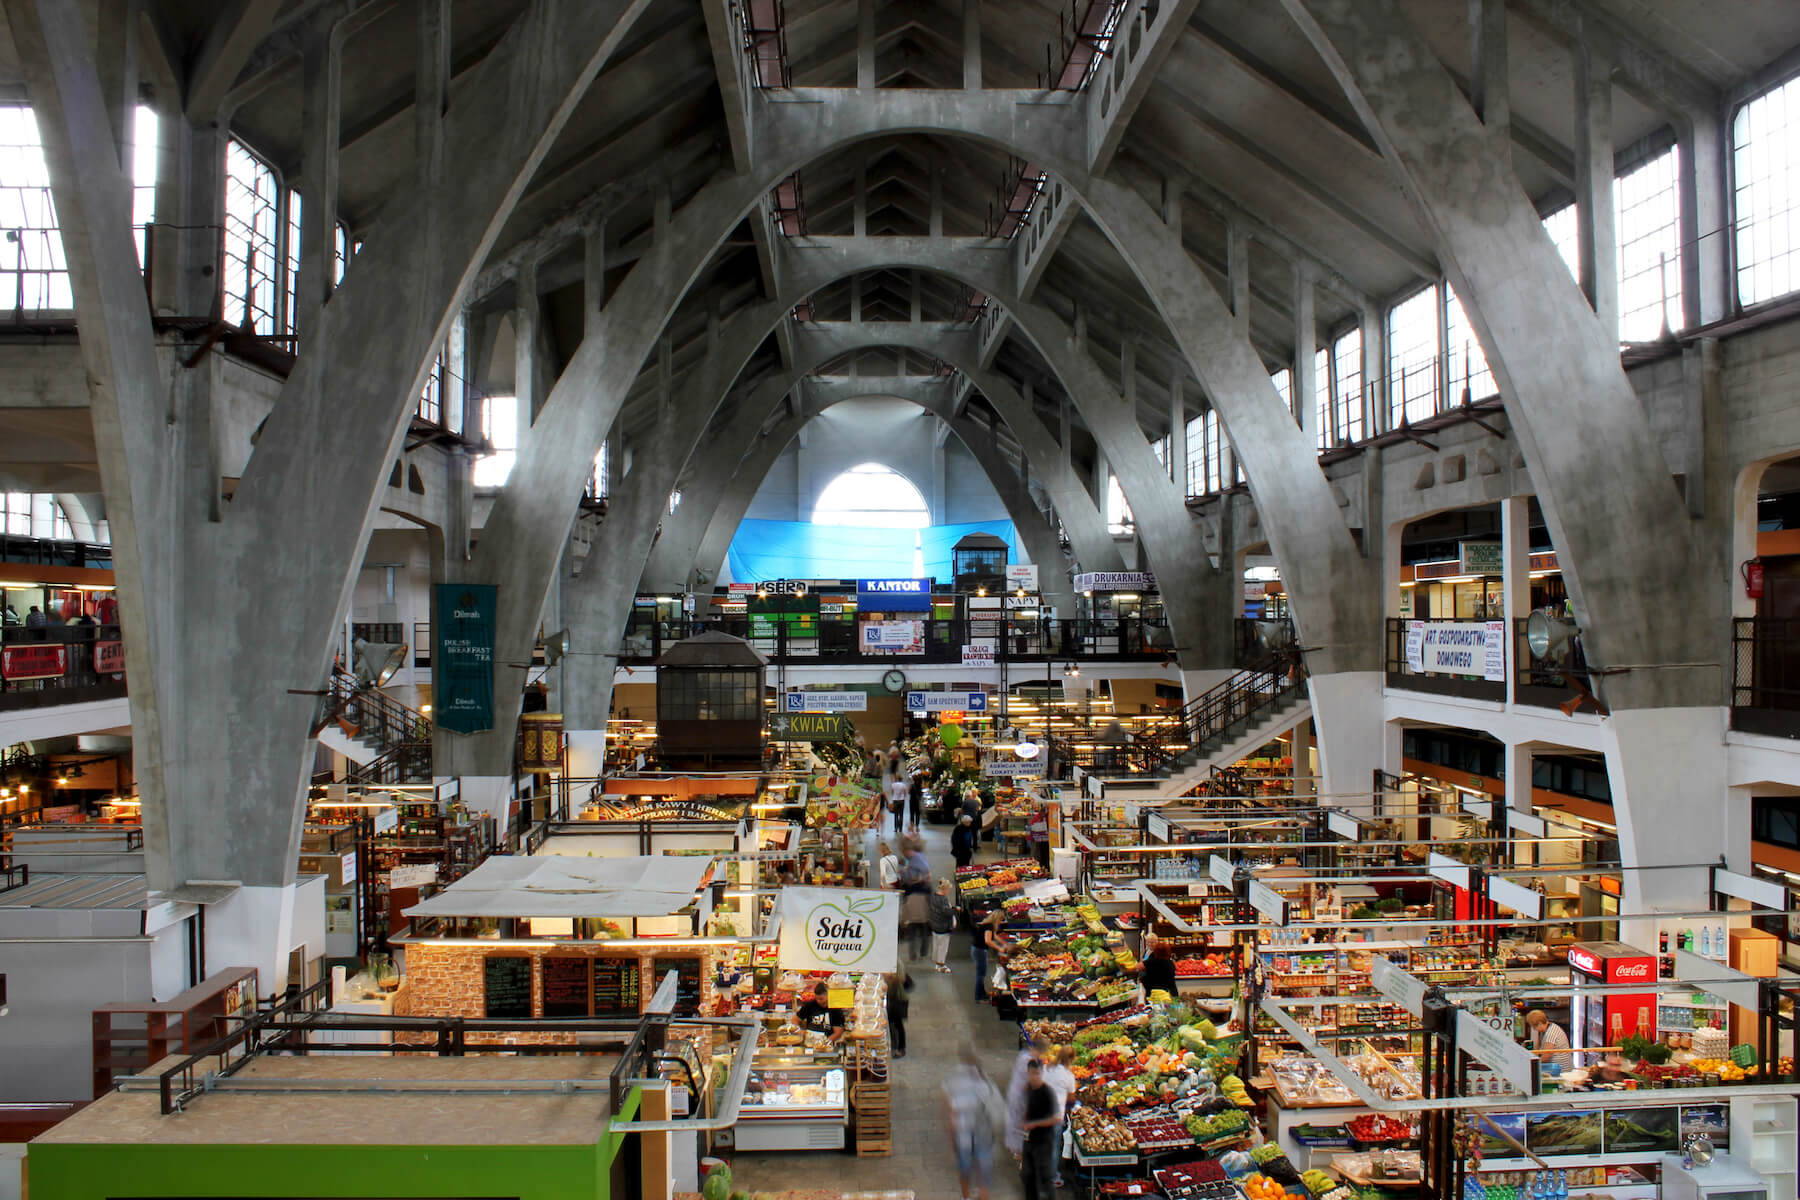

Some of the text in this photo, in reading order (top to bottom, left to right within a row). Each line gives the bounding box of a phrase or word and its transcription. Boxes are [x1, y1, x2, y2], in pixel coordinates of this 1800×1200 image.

[1094, 573, 1142, 583] DRUKARNIA
[755, 582, 806, 593] KSERO
[866, 581, 921, 591] KANTOR
[447, 646, 491, 654] BREAKFAST
[475, 653, 491, 661] TEA
[1436, 651, 1473, 668] DOMOWEGO
[790, 716, 841, 733] KWIATY
[656, 801, 688, 809] KAWY
[697, 804, 737, 821] HERBA
[816, 916, 864, 939] Soki
[815, 939, 862, 954] Targowa
[1615, 964, 1648, 977] Coca-Cola
